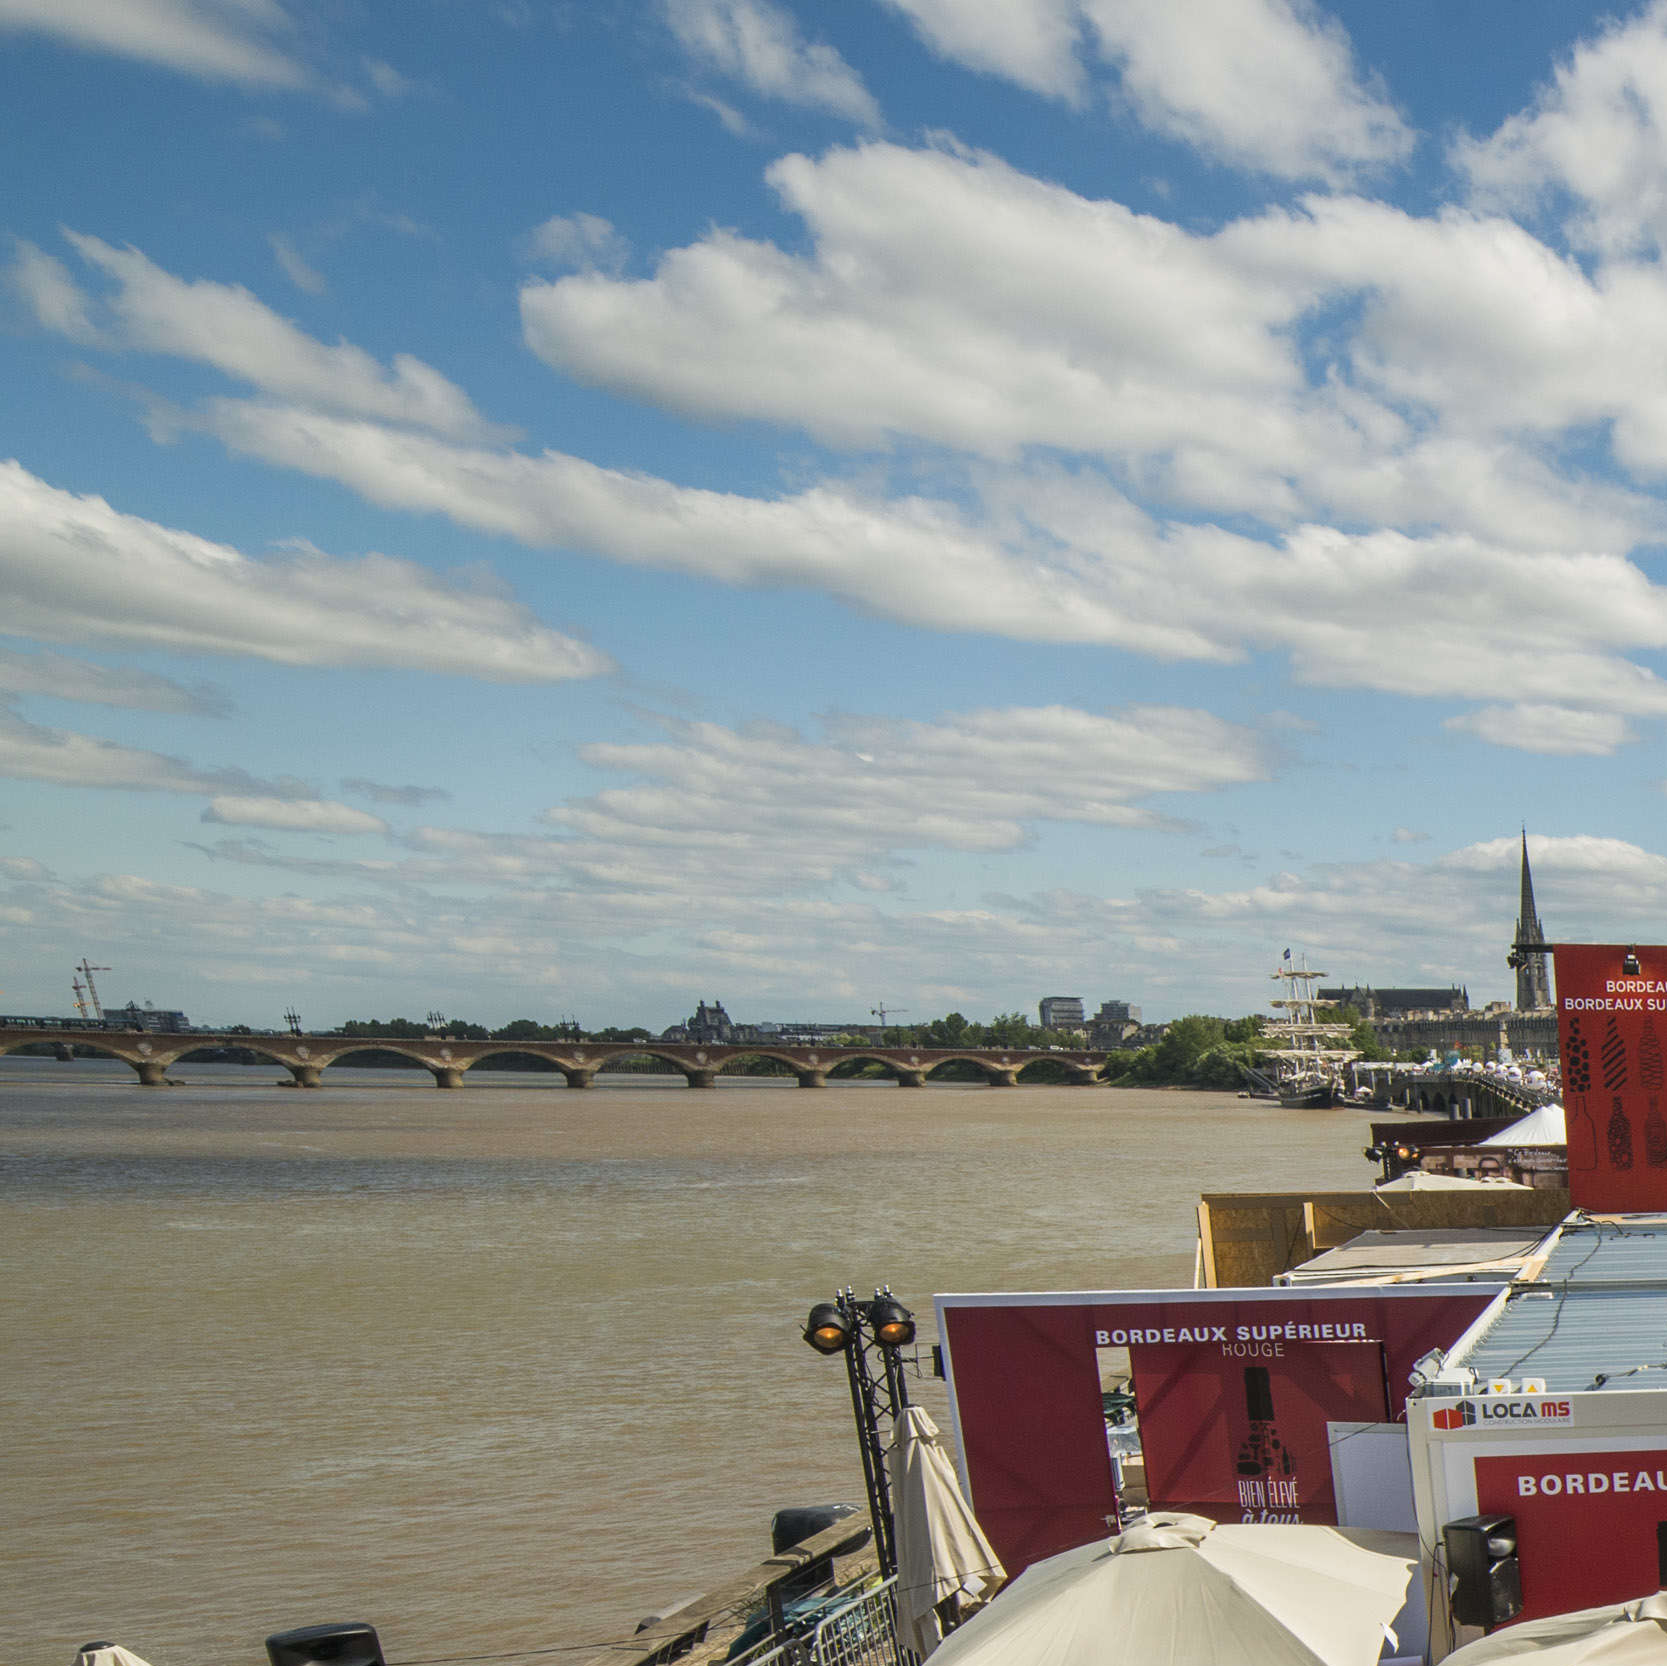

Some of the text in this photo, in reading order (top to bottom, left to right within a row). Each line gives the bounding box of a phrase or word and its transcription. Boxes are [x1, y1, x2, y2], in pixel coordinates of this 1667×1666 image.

[1564, 998, 1643, 1010] BORDEAUX
[1095, 1321, 1367, 1345] BORDEAUX SUPÉRIEUR
[1222, 1343, 1285, 1358] ROUGE
[1482, 1402, 1570, 1419] LOCA MS
[1238, 1475, 1301, 1508] BIEN ÉLEVÉ
